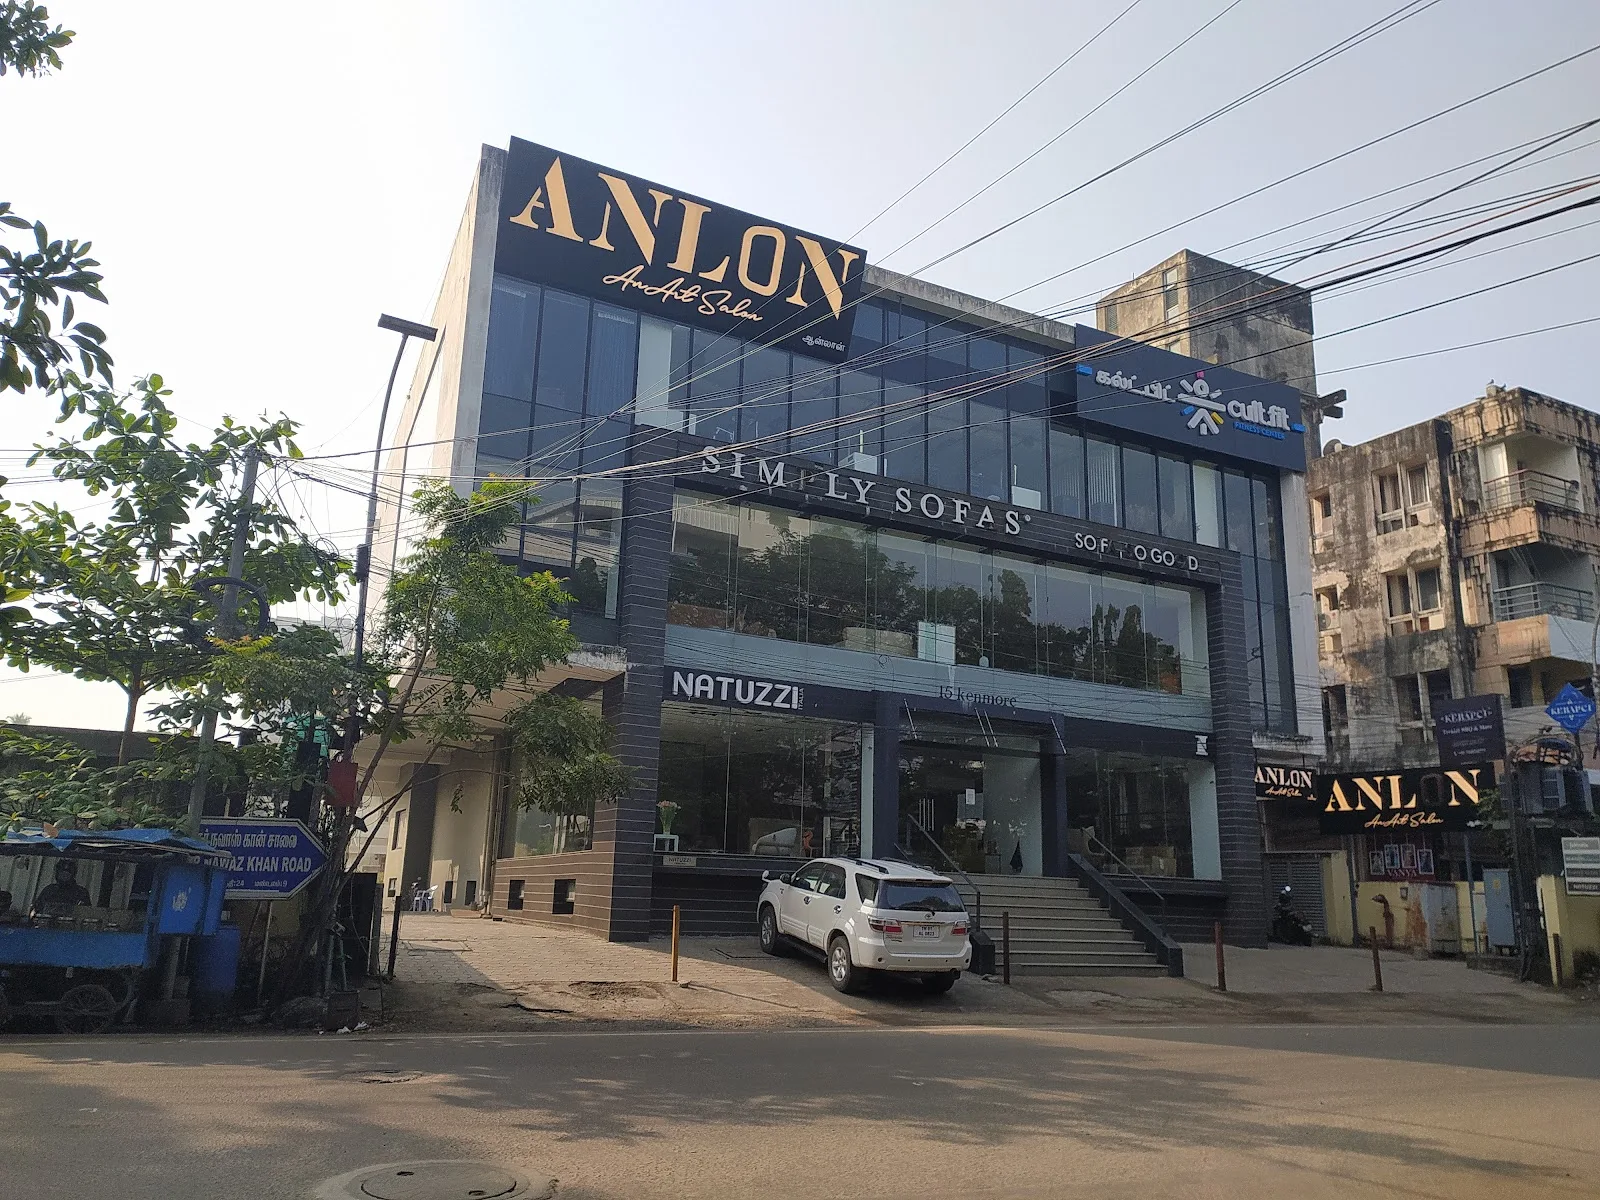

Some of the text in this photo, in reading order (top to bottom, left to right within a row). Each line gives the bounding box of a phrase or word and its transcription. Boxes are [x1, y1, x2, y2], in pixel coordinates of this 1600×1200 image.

[509, 156, 866, 320] ANLON
[602, 264, 763, 322] An Art Salon
[801, 335, 846, 351] ஆன்லான்
[1227, 400, 1291, 431] cult.fit
[701, 445, 876, 504] SIMLY
[1150, 548, 1199, 571] GOD
[672, 671, 799, 709] NATUZZI
[957, 687, 1017, 708] kenmore
[1254, 766, 1312, 789] ANLON
[243, 830, 267, 848] கான்
[268, 834, 298, 849] சாலை
[247, 856, 278, 872] KHAN
[282, 857, 312, 872] ROAD
